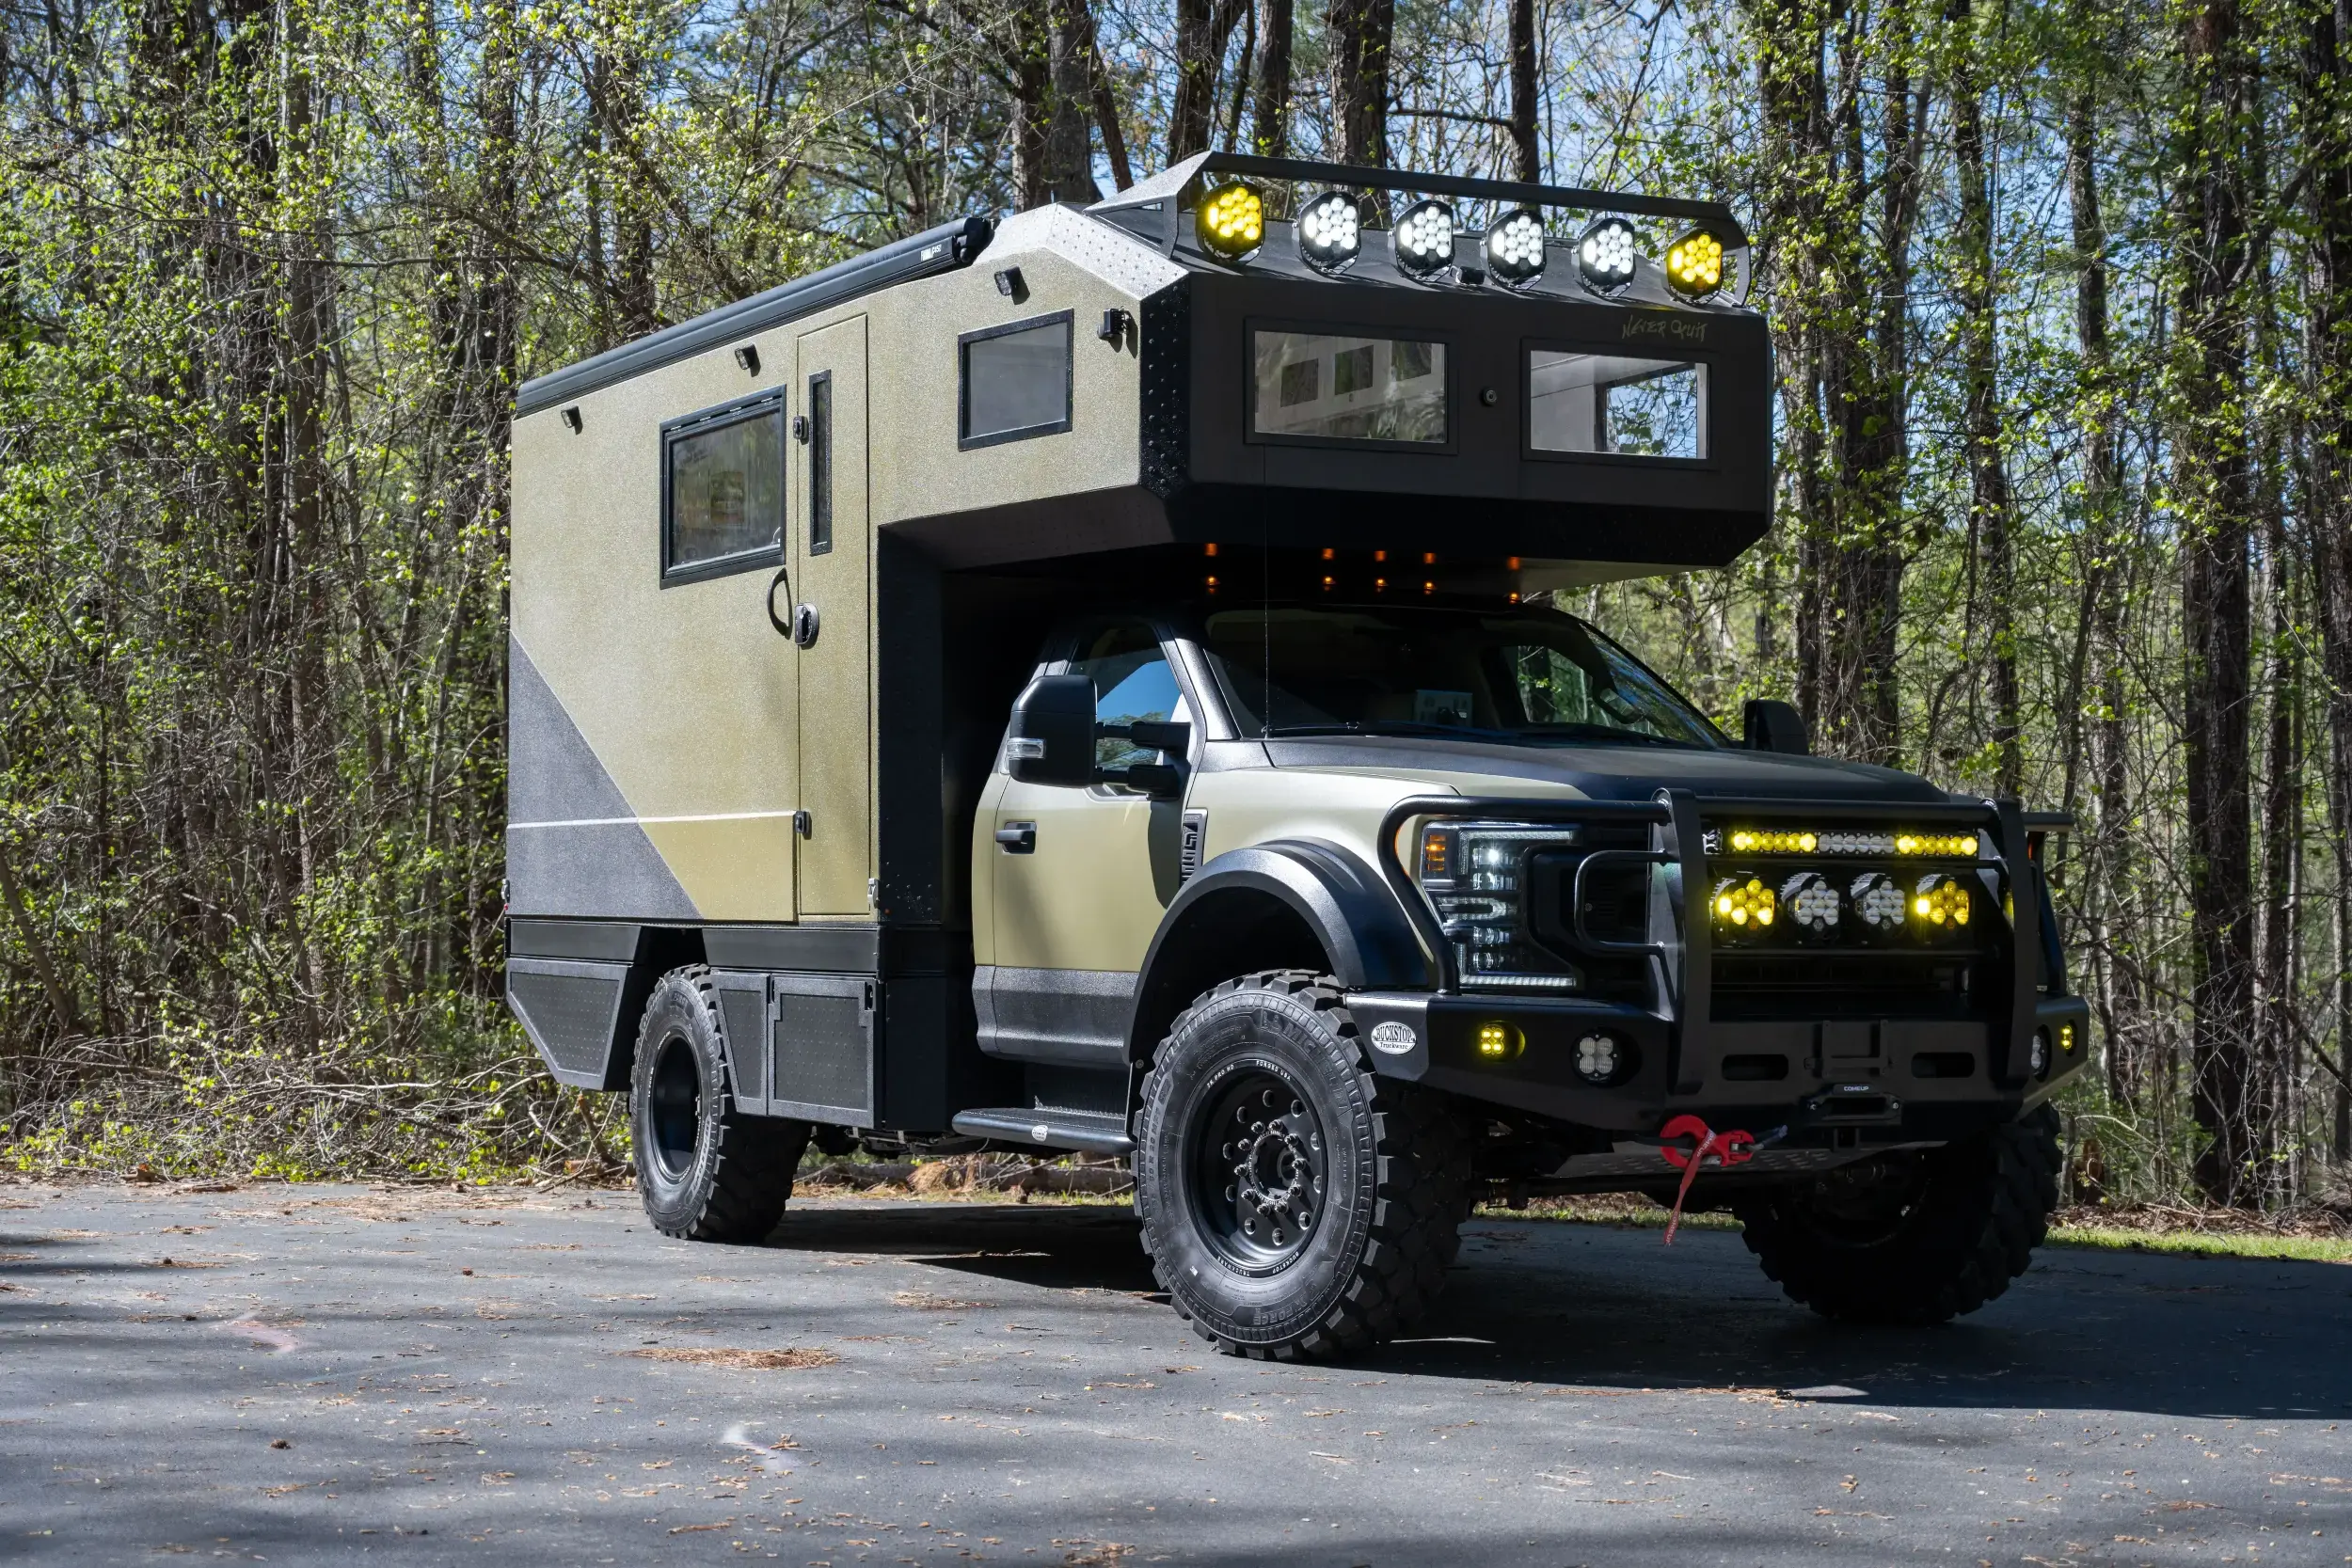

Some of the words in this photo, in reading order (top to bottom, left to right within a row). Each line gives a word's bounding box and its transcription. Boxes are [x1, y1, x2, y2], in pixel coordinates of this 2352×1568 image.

[1621, 314, 1666, 340] NEVER
[1375, 1024, 1412, 1042] BUCKSTOP
[1379, 1041, 1408, 1050] Truckware
[1696, 1132, 1715, 1157] OMEUP
